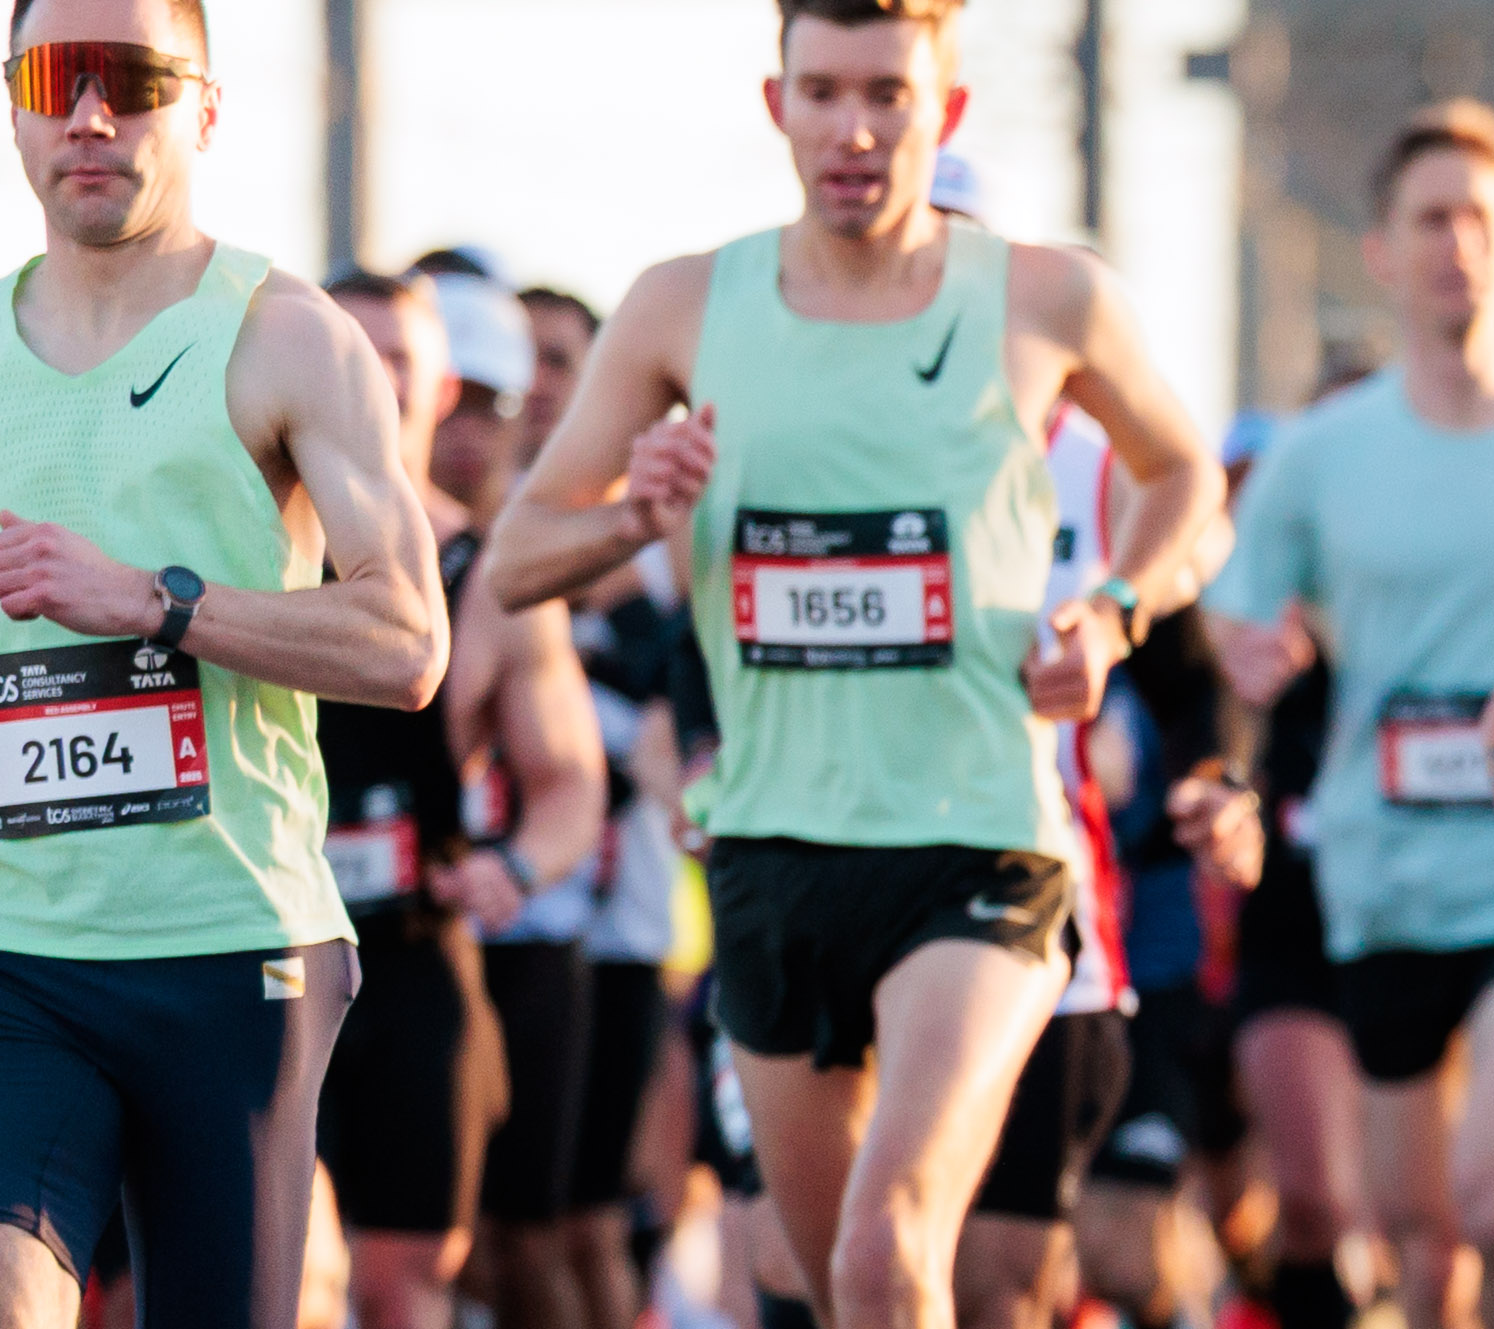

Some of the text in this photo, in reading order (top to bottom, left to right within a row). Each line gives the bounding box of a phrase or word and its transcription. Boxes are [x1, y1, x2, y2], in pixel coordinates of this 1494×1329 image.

[787, 587, 886, 627] 1656
[20, 664, 47, 676] TATA
[21, 672, 87, 689] CONSULTANCY
[130, 672, 176, 689] TATA
[22, 687, 63, 701] SERVICES
[179, 736, 197, 759] A
[22, 731, 134, 784] 2164
